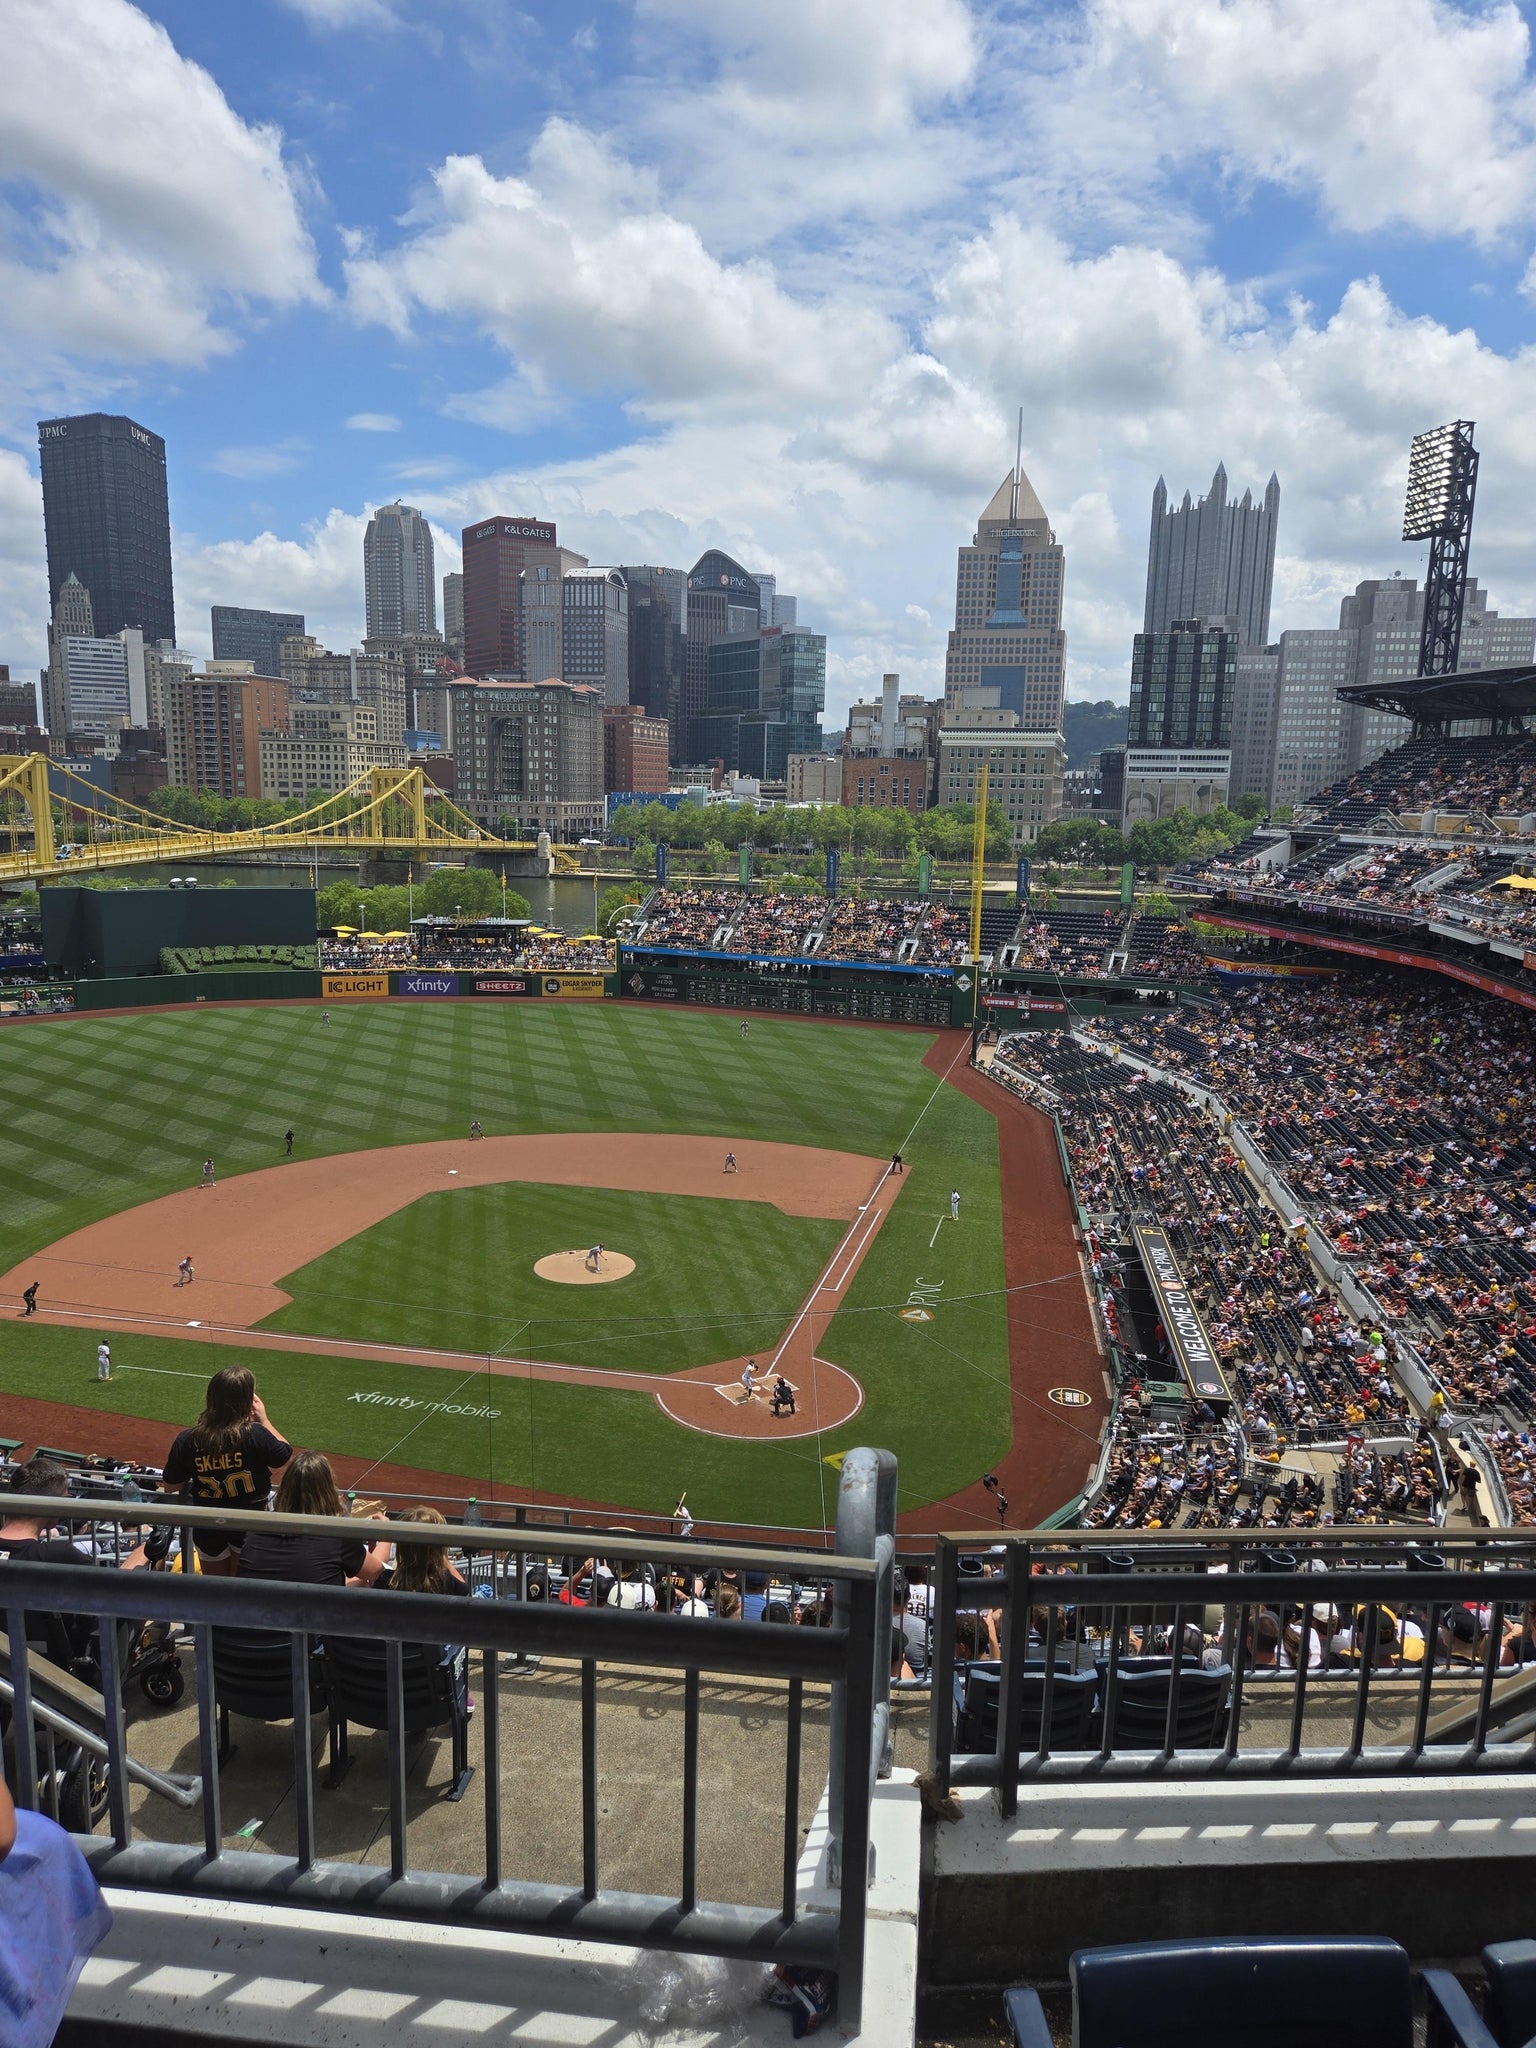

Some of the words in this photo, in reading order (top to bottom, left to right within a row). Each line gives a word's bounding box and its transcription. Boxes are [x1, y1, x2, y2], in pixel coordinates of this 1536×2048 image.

[39, 425, 67, 439] UPMC
[131, 426, 151, 446] UPMC
[504, 525, 521, 535] K&L
[522, 528, 551, 539] GATES
[693, 576, 704, 586] PNC
[730, 576, 747, 588] PNC
[1238, 963, 1274, 975] Surfside
[328, 981, 343, 993] IC
[345, 981, 384, 992] LIGHT
[407, 979, 451, 993] xfinity
[478, 982, 523, 991] SHEETZ
[1149, 1246, 1167, 1264] PARK
[1156, 1264, 1177, 1282] PNC
[907, 1277, 944, 1307] PNC
[1165, 1291, 1187, 1304] TO
[1171, 1306, 1211, 1362] WELCOME
[346, 1391, 425, 1409] xfinity
[424, 1403, 502, 1419] mobile
[194, 1452, 243, 1473] SKENES
